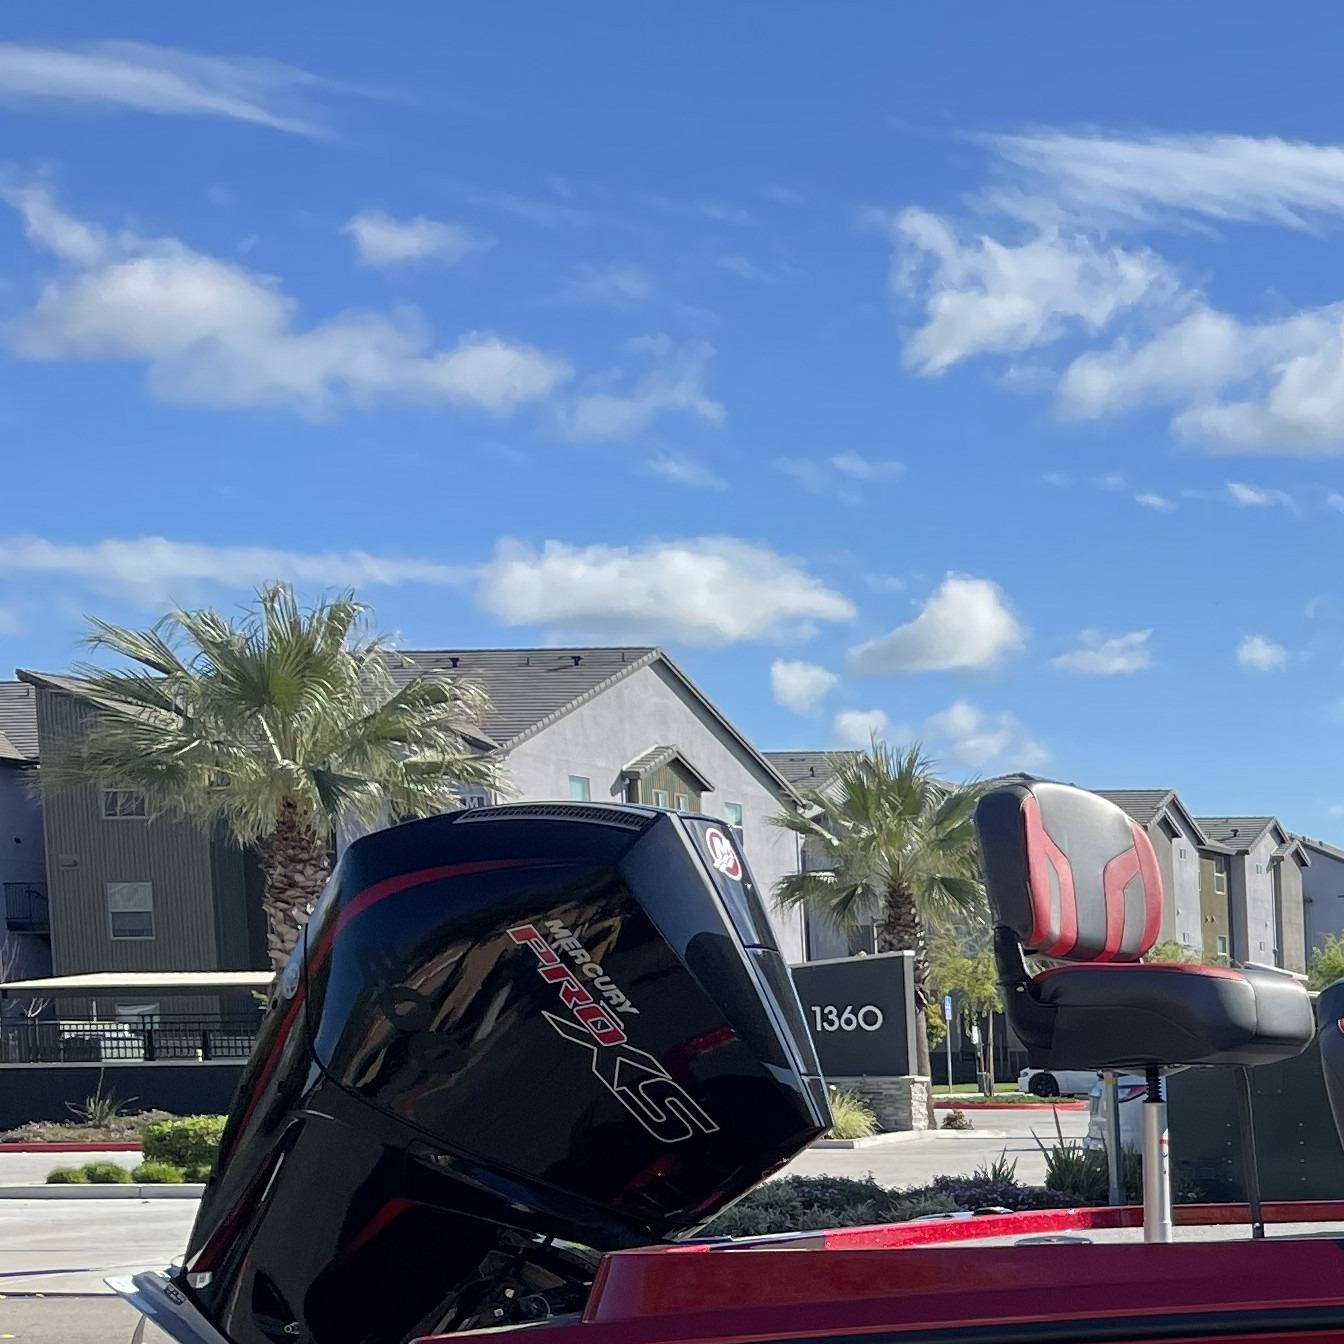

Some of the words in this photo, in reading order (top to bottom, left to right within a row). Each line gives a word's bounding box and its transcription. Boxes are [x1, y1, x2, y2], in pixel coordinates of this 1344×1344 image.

[506, 924, 628, 1047] PRO
[545, 919, 640, 1015] MERCURY
[811, 1005, 883, 1032] 1360
[541, 1000, 720, 1143] XS
